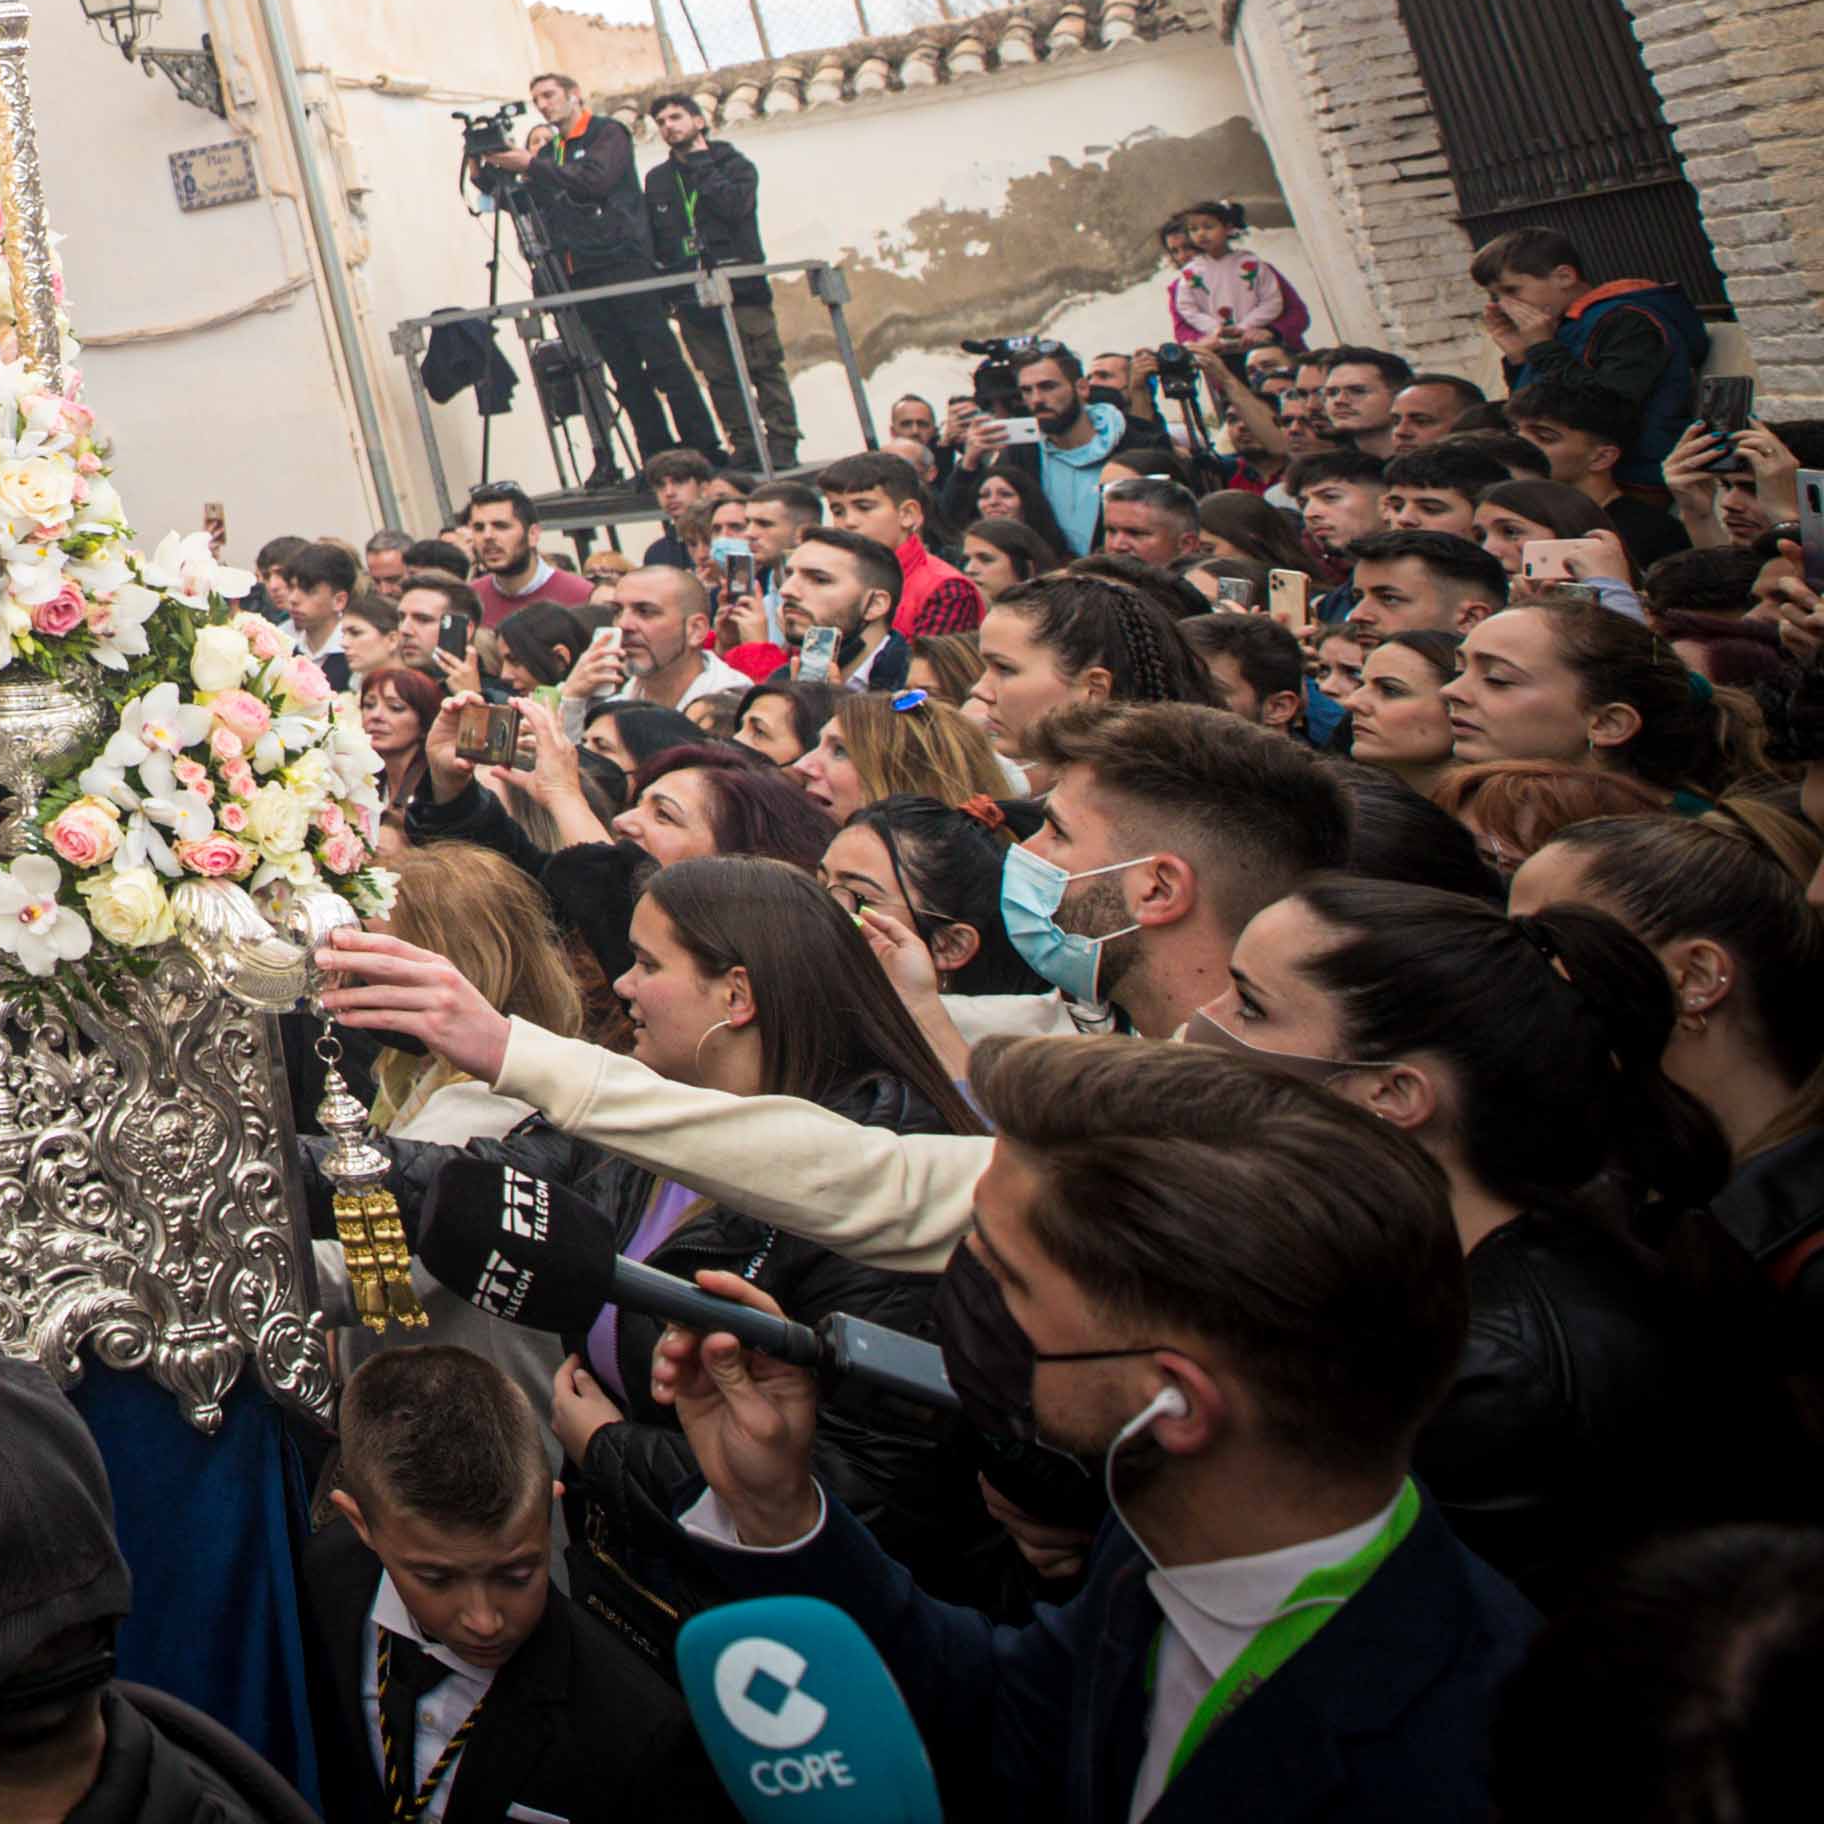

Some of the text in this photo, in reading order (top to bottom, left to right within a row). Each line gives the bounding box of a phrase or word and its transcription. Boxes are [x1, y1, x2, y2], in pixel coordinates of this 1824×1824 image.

[502, 1165, 534, 1239] PTV
[533, 1178, 549, 1242] TELECOM
[470, 1248, 518, 1315] PTV
[750, 1749, 856, 1796] COPE
